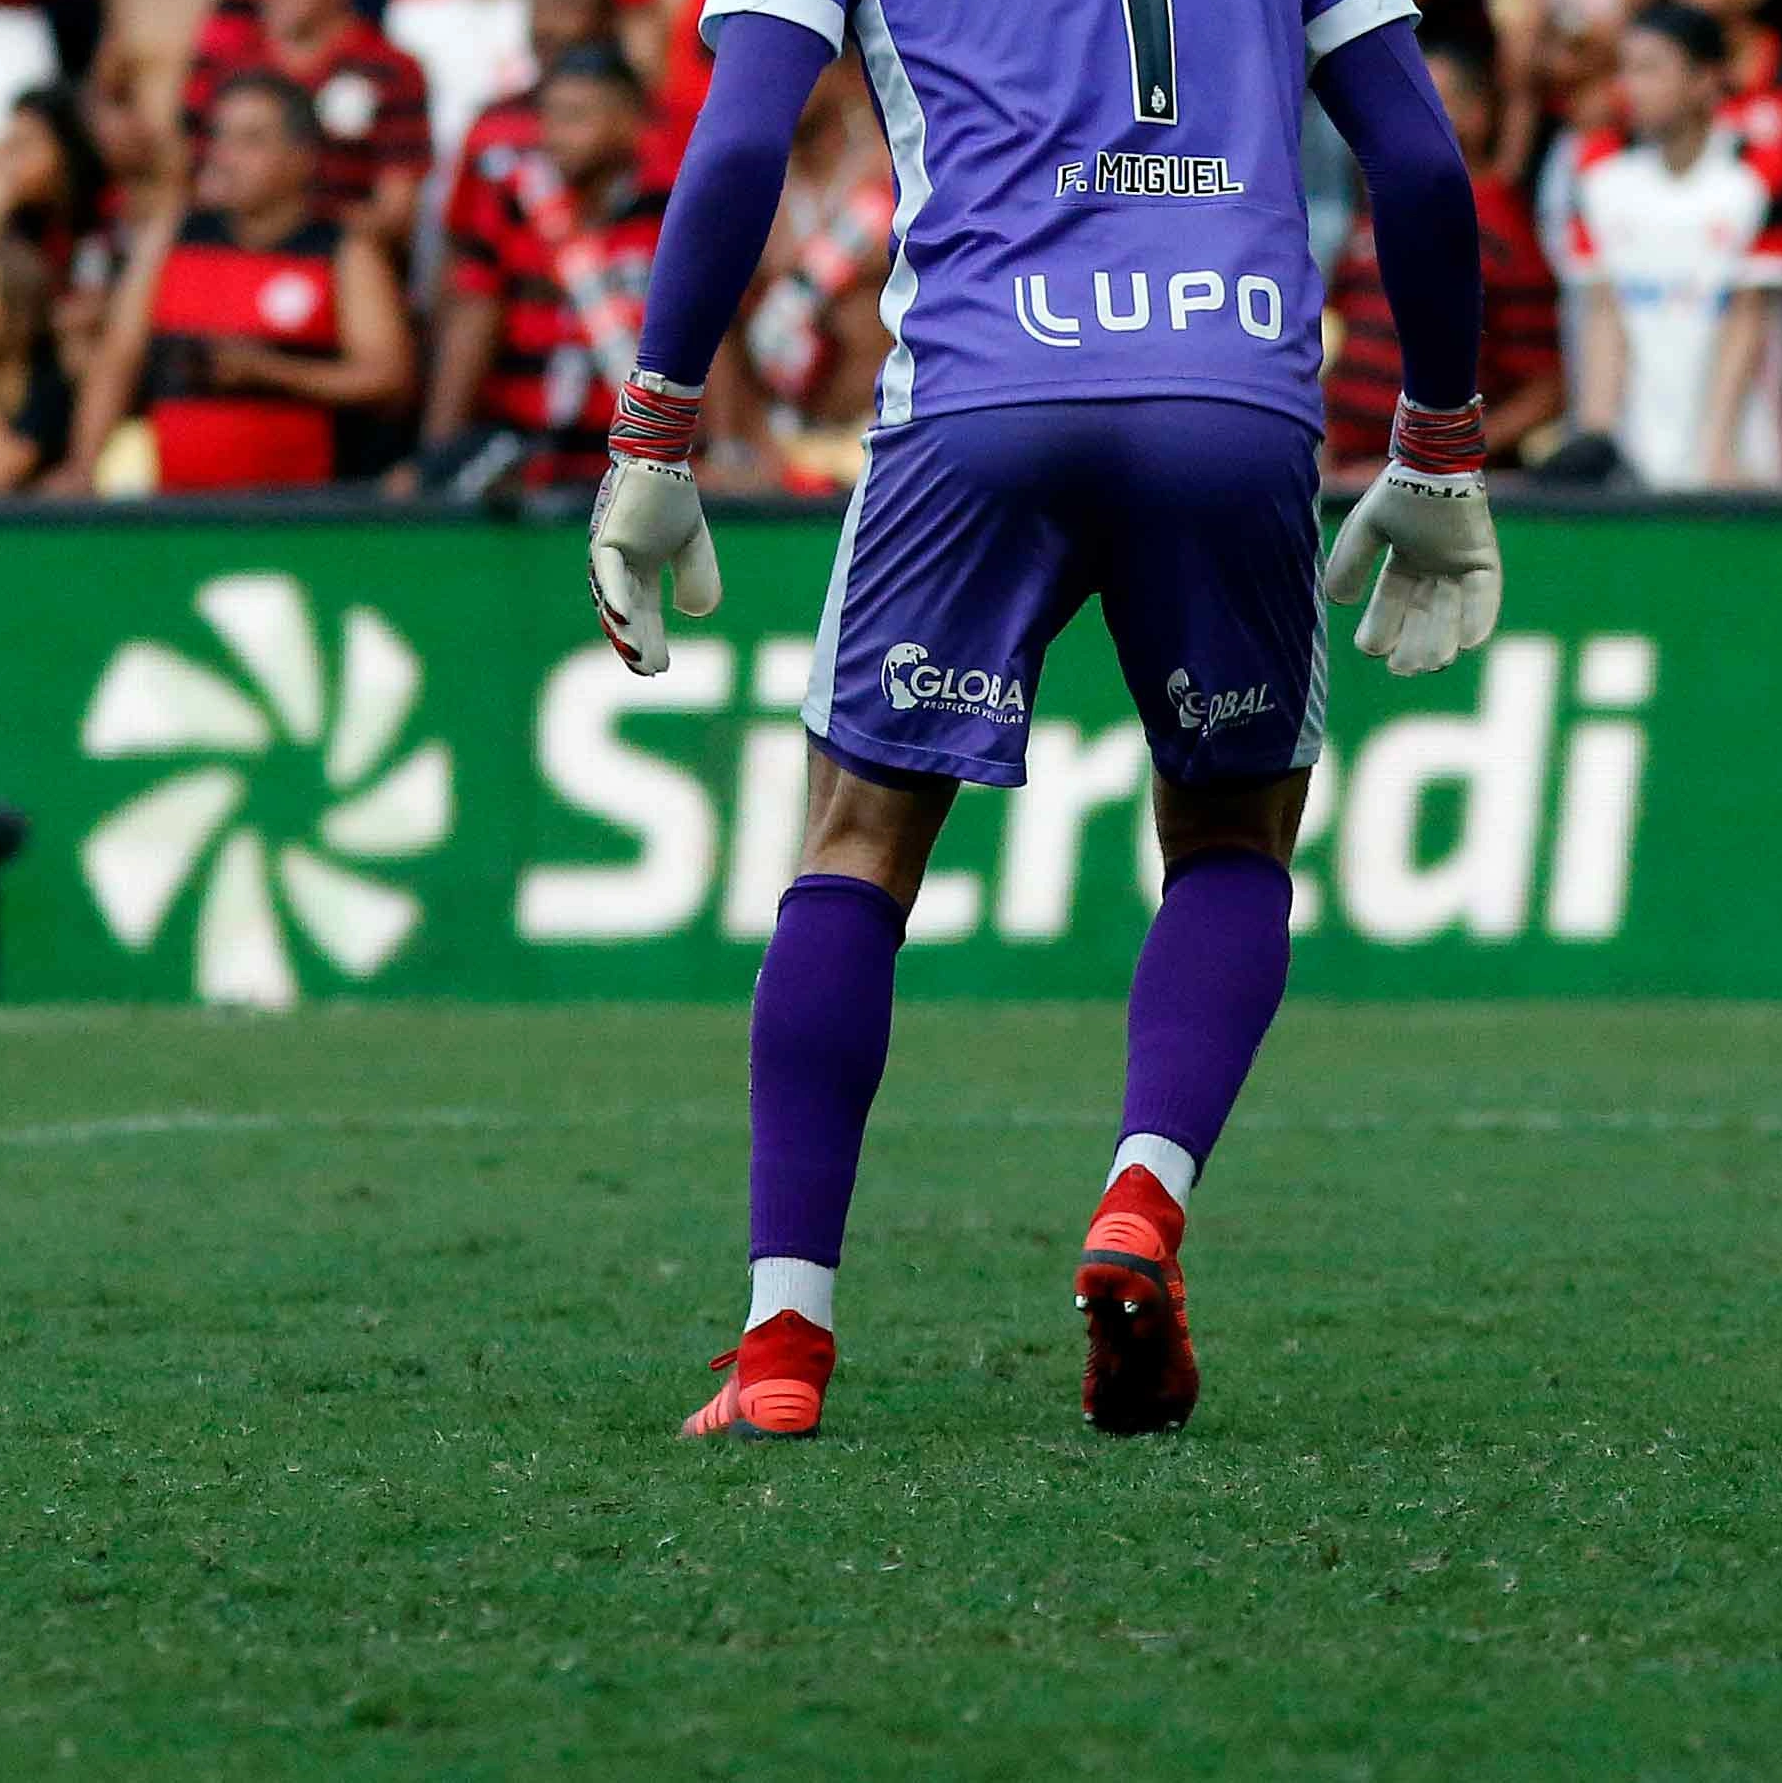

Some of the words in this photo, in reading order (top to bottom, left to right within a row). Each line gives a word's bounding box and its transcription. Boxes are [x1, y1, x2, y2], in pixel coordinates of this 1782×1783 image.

[1055, 161, 1088, 198] F.
[1095, 151, 1244, 198] MIGUEL
[1014, 270, 1283, 348] LUPO
[515, 636, 1657, 942] Sirdi
